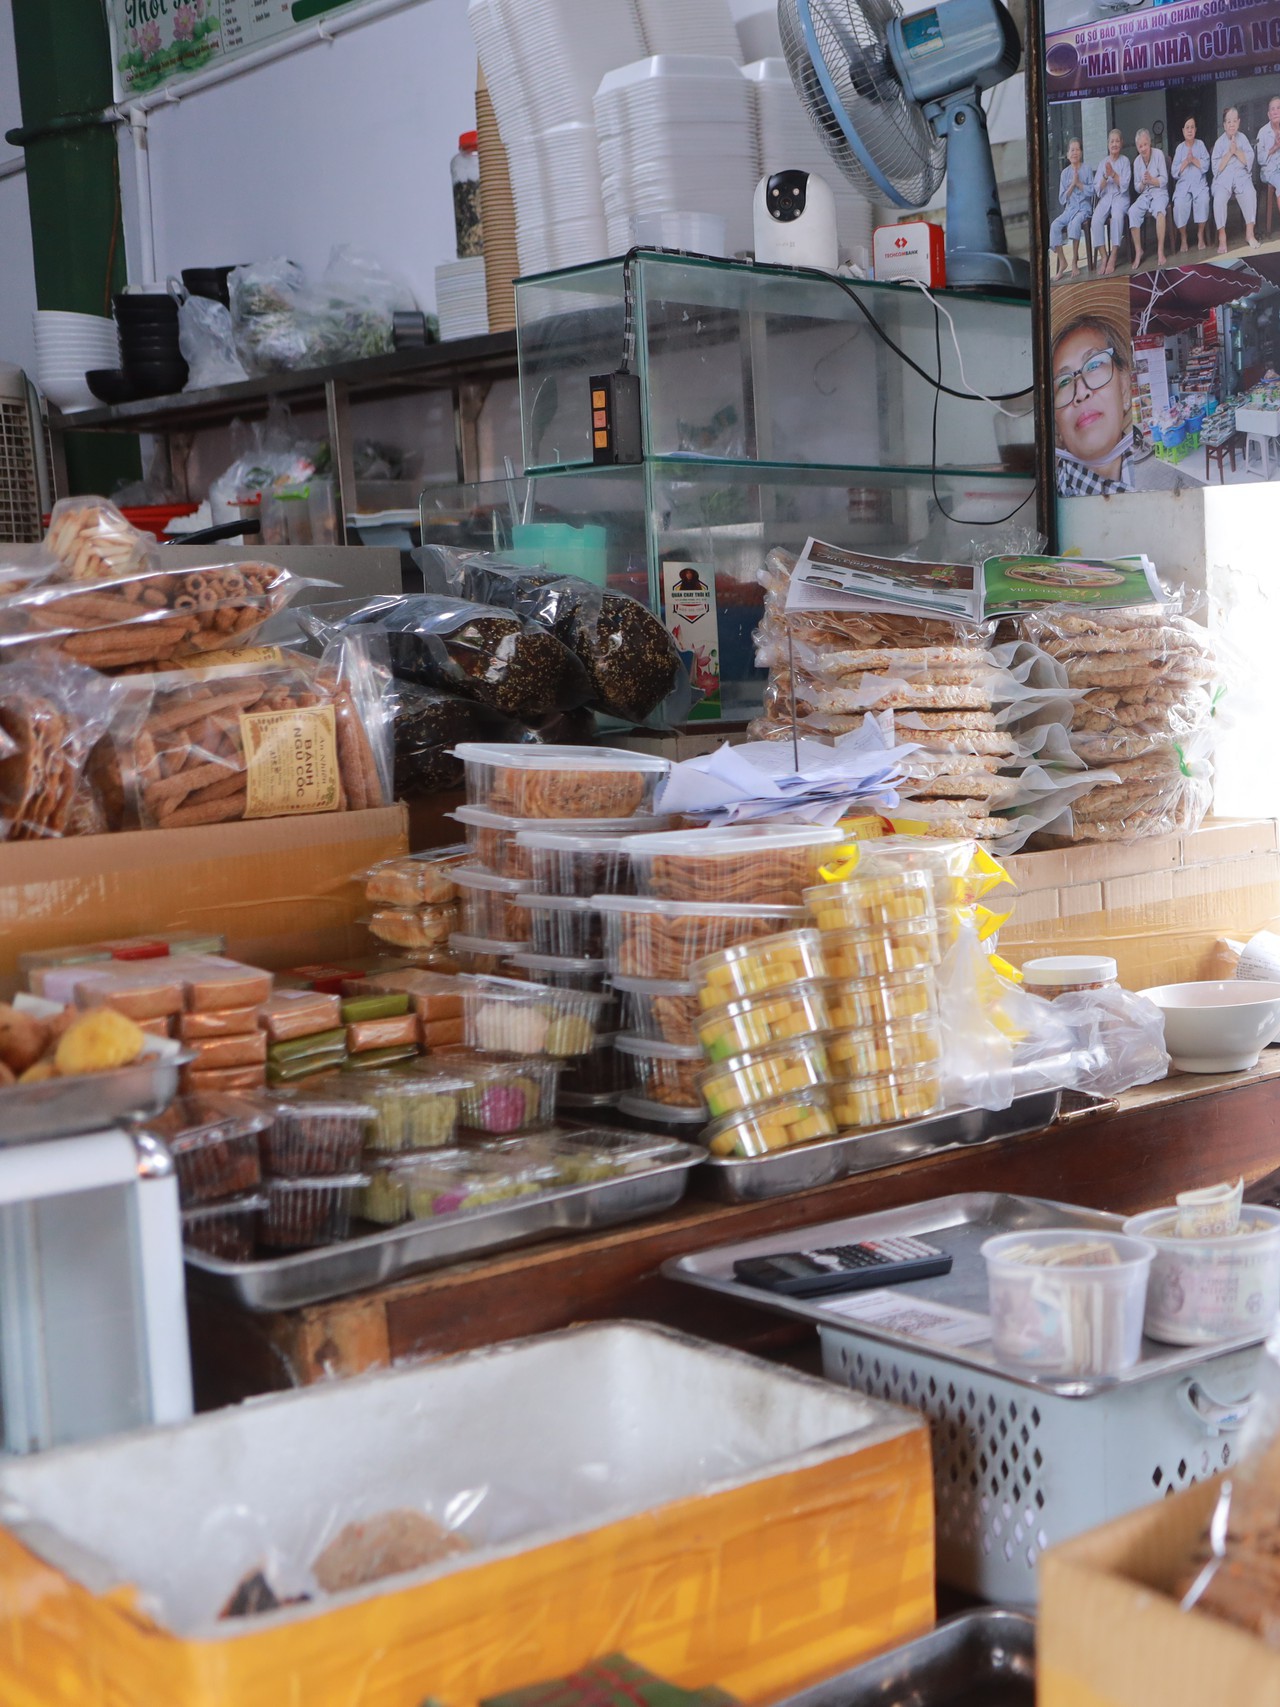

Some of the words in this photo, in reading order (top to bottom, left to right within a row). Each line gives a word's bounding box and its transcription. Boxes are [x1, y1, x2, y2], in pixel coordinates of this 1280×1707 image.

[1122, 38, 1149, 73] ẤM
[1153, 32, 1193, 67] NHÀ
[1198, 22, 1246, 59] CỦA
[884, 249, 919, 259] TECHCOMBANK
